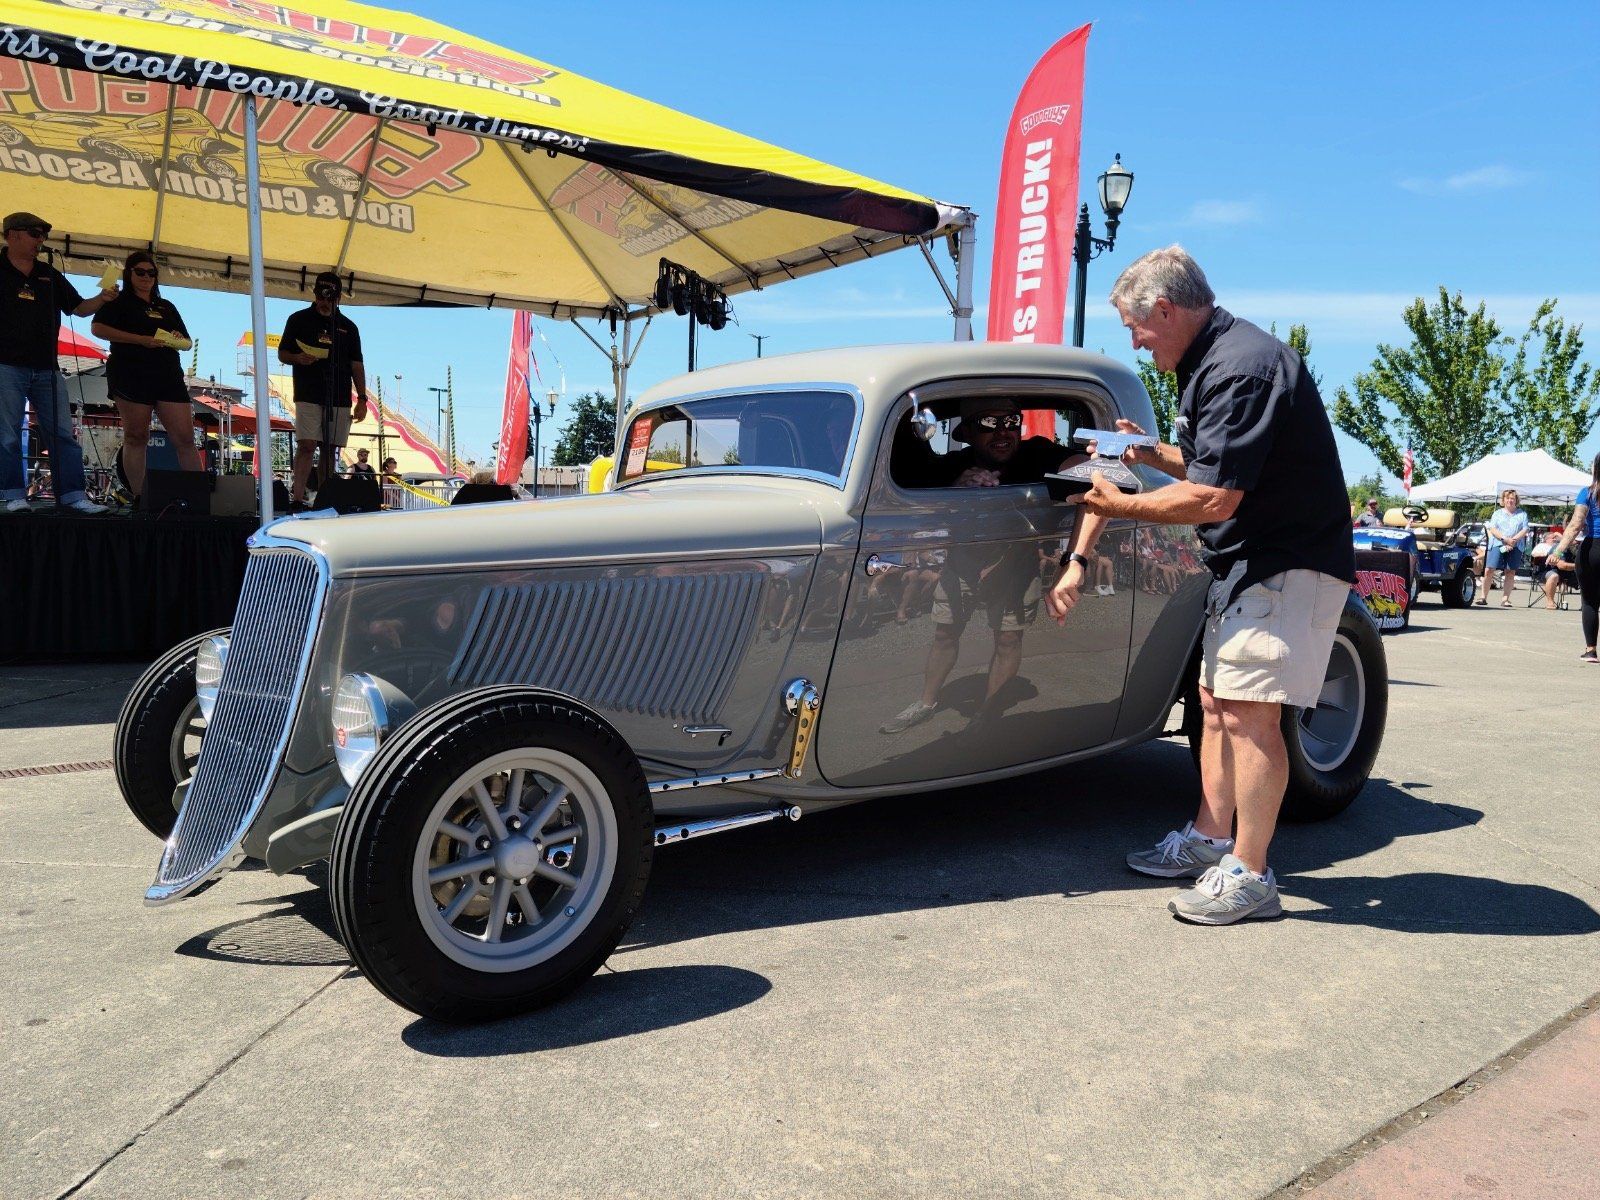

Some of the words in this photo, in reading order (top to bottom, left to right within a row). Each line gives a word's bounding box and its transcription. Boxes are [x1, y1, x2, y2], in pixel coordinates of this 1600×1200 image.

[75, 37, 187, 82] Cool
[359, 88, 469, 125] Good
[474, 112, 591, 153] Times!
[1015, 137, 1053, 299] TRUCK!
